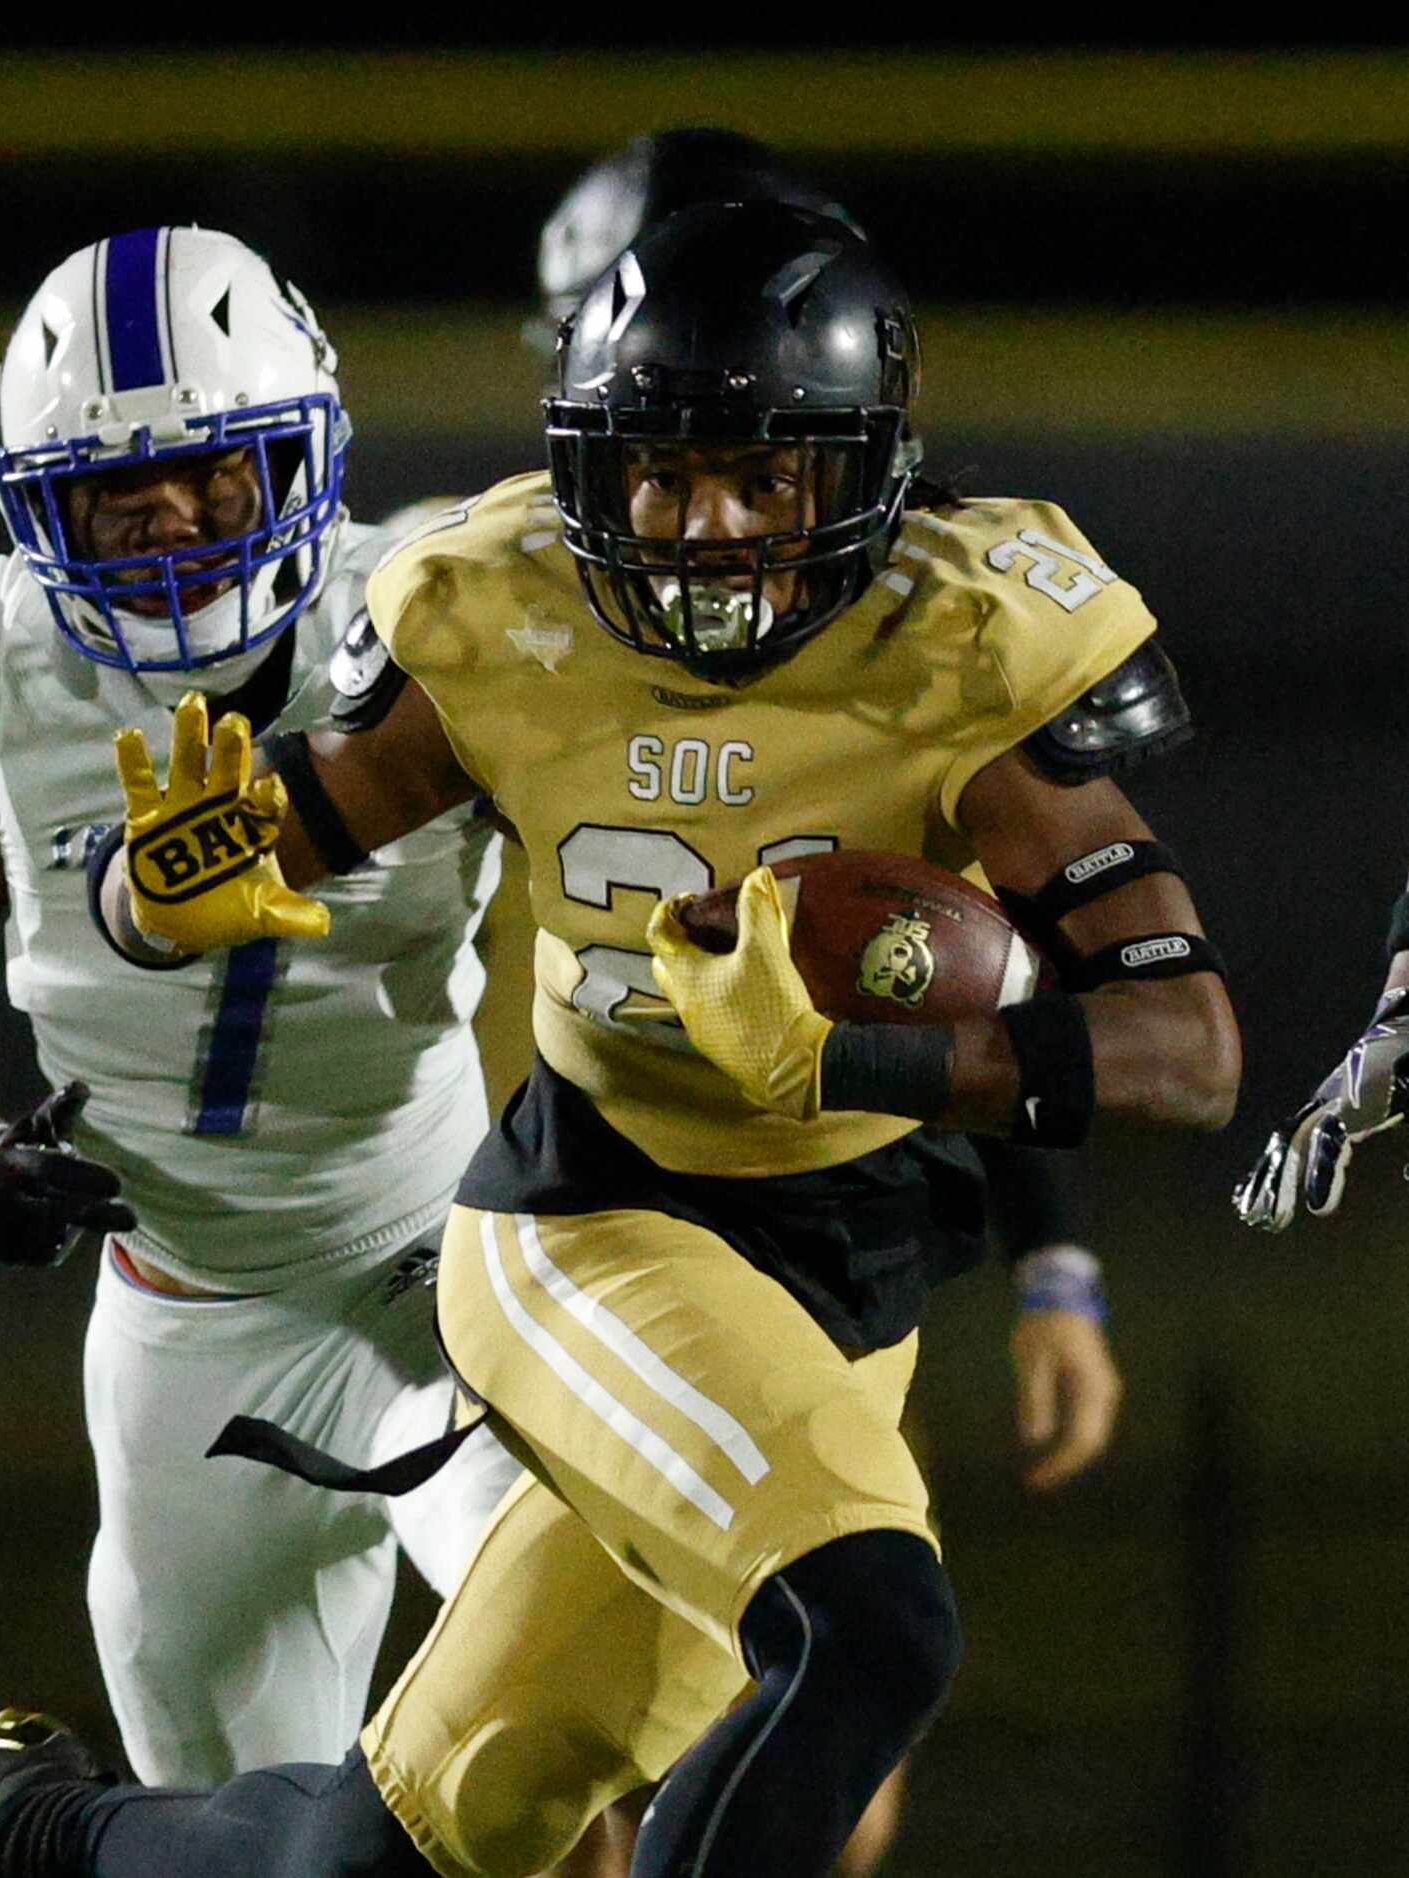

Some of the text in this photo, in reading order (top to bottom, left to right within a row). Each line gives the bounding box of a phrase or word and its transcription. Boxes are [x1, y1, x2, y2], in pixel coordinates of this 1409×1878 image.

[985, 529, 1118, 614] 21
[627, 734, 755, 807] SOC
[1070, 845, 1129, 879] BATTLE
[557, 821, 838, 1030] 2
[1126, 940, 1184, 962] BATTLE
